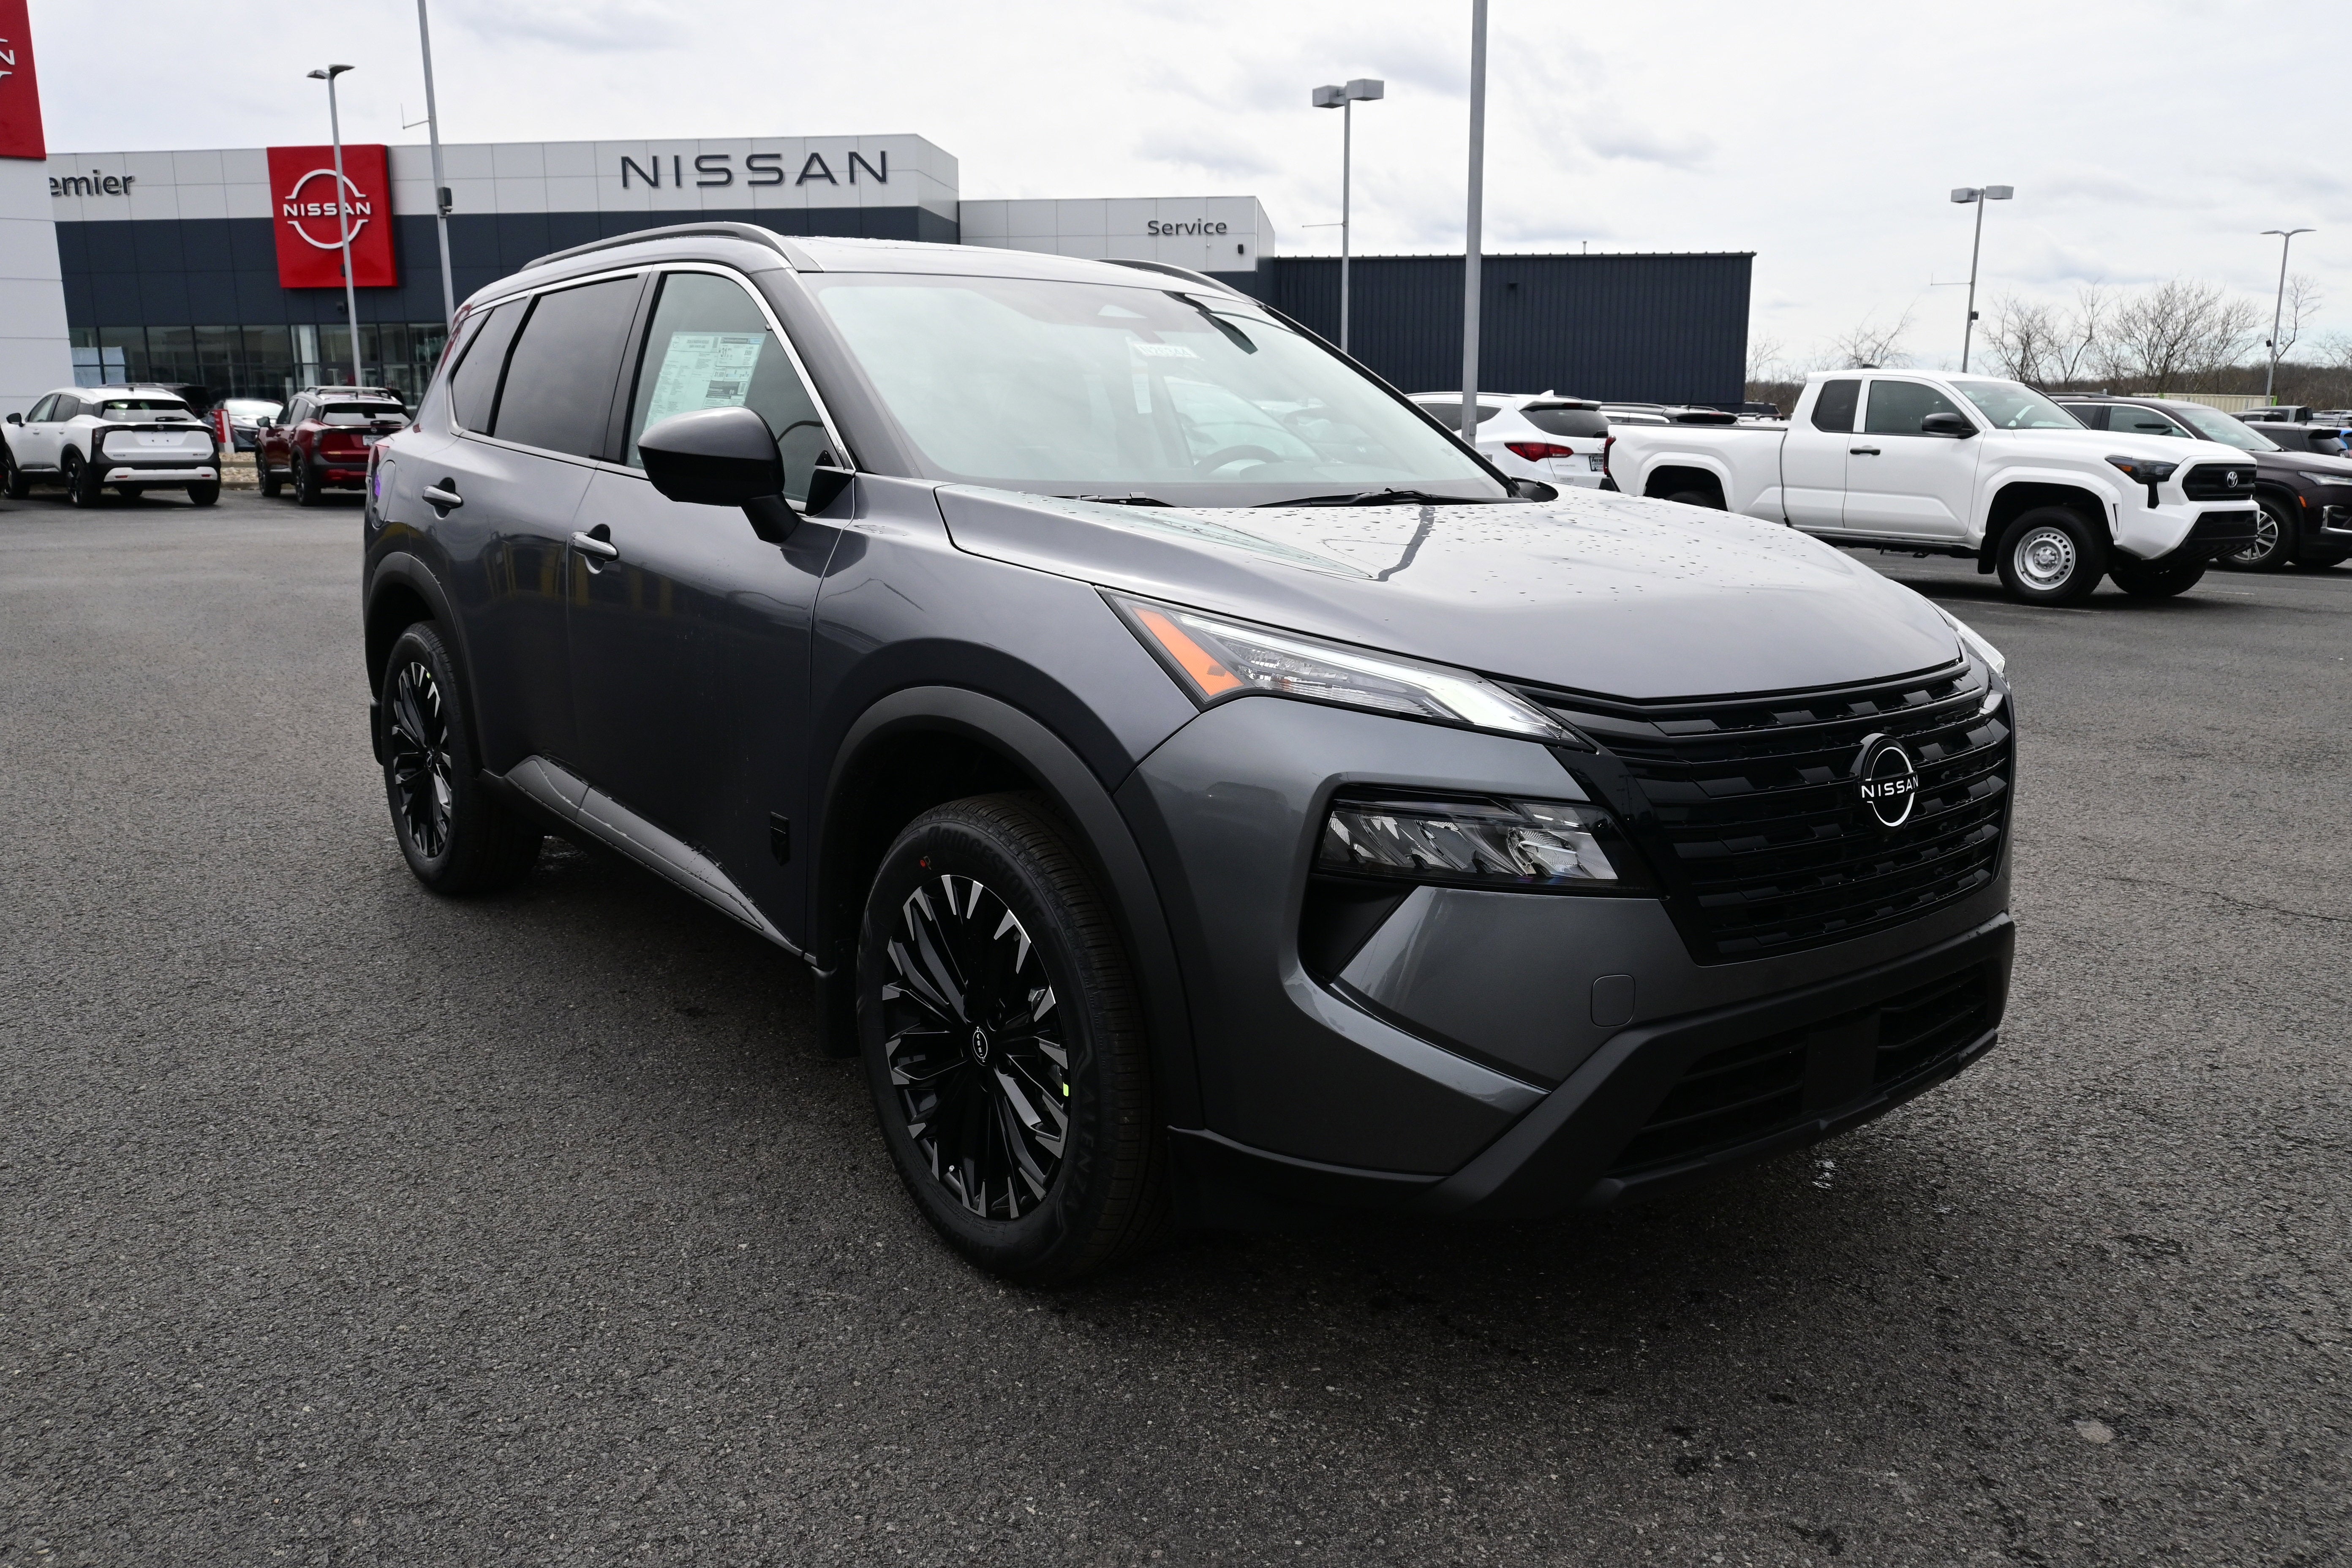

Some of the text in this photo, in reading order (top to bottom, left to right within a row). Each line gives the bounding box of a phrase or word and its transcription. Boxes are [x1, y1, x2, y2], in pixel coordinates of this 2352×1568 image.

[621, 150, 887, 188] NISSAN
[1147, 218, 1227, 236] Service
[1861, 774, 1919, 798] NISSAN
[925, 825, 1045, 928] BRIDGESTONE
[975, 1026, 986, 1062] NISSAN
